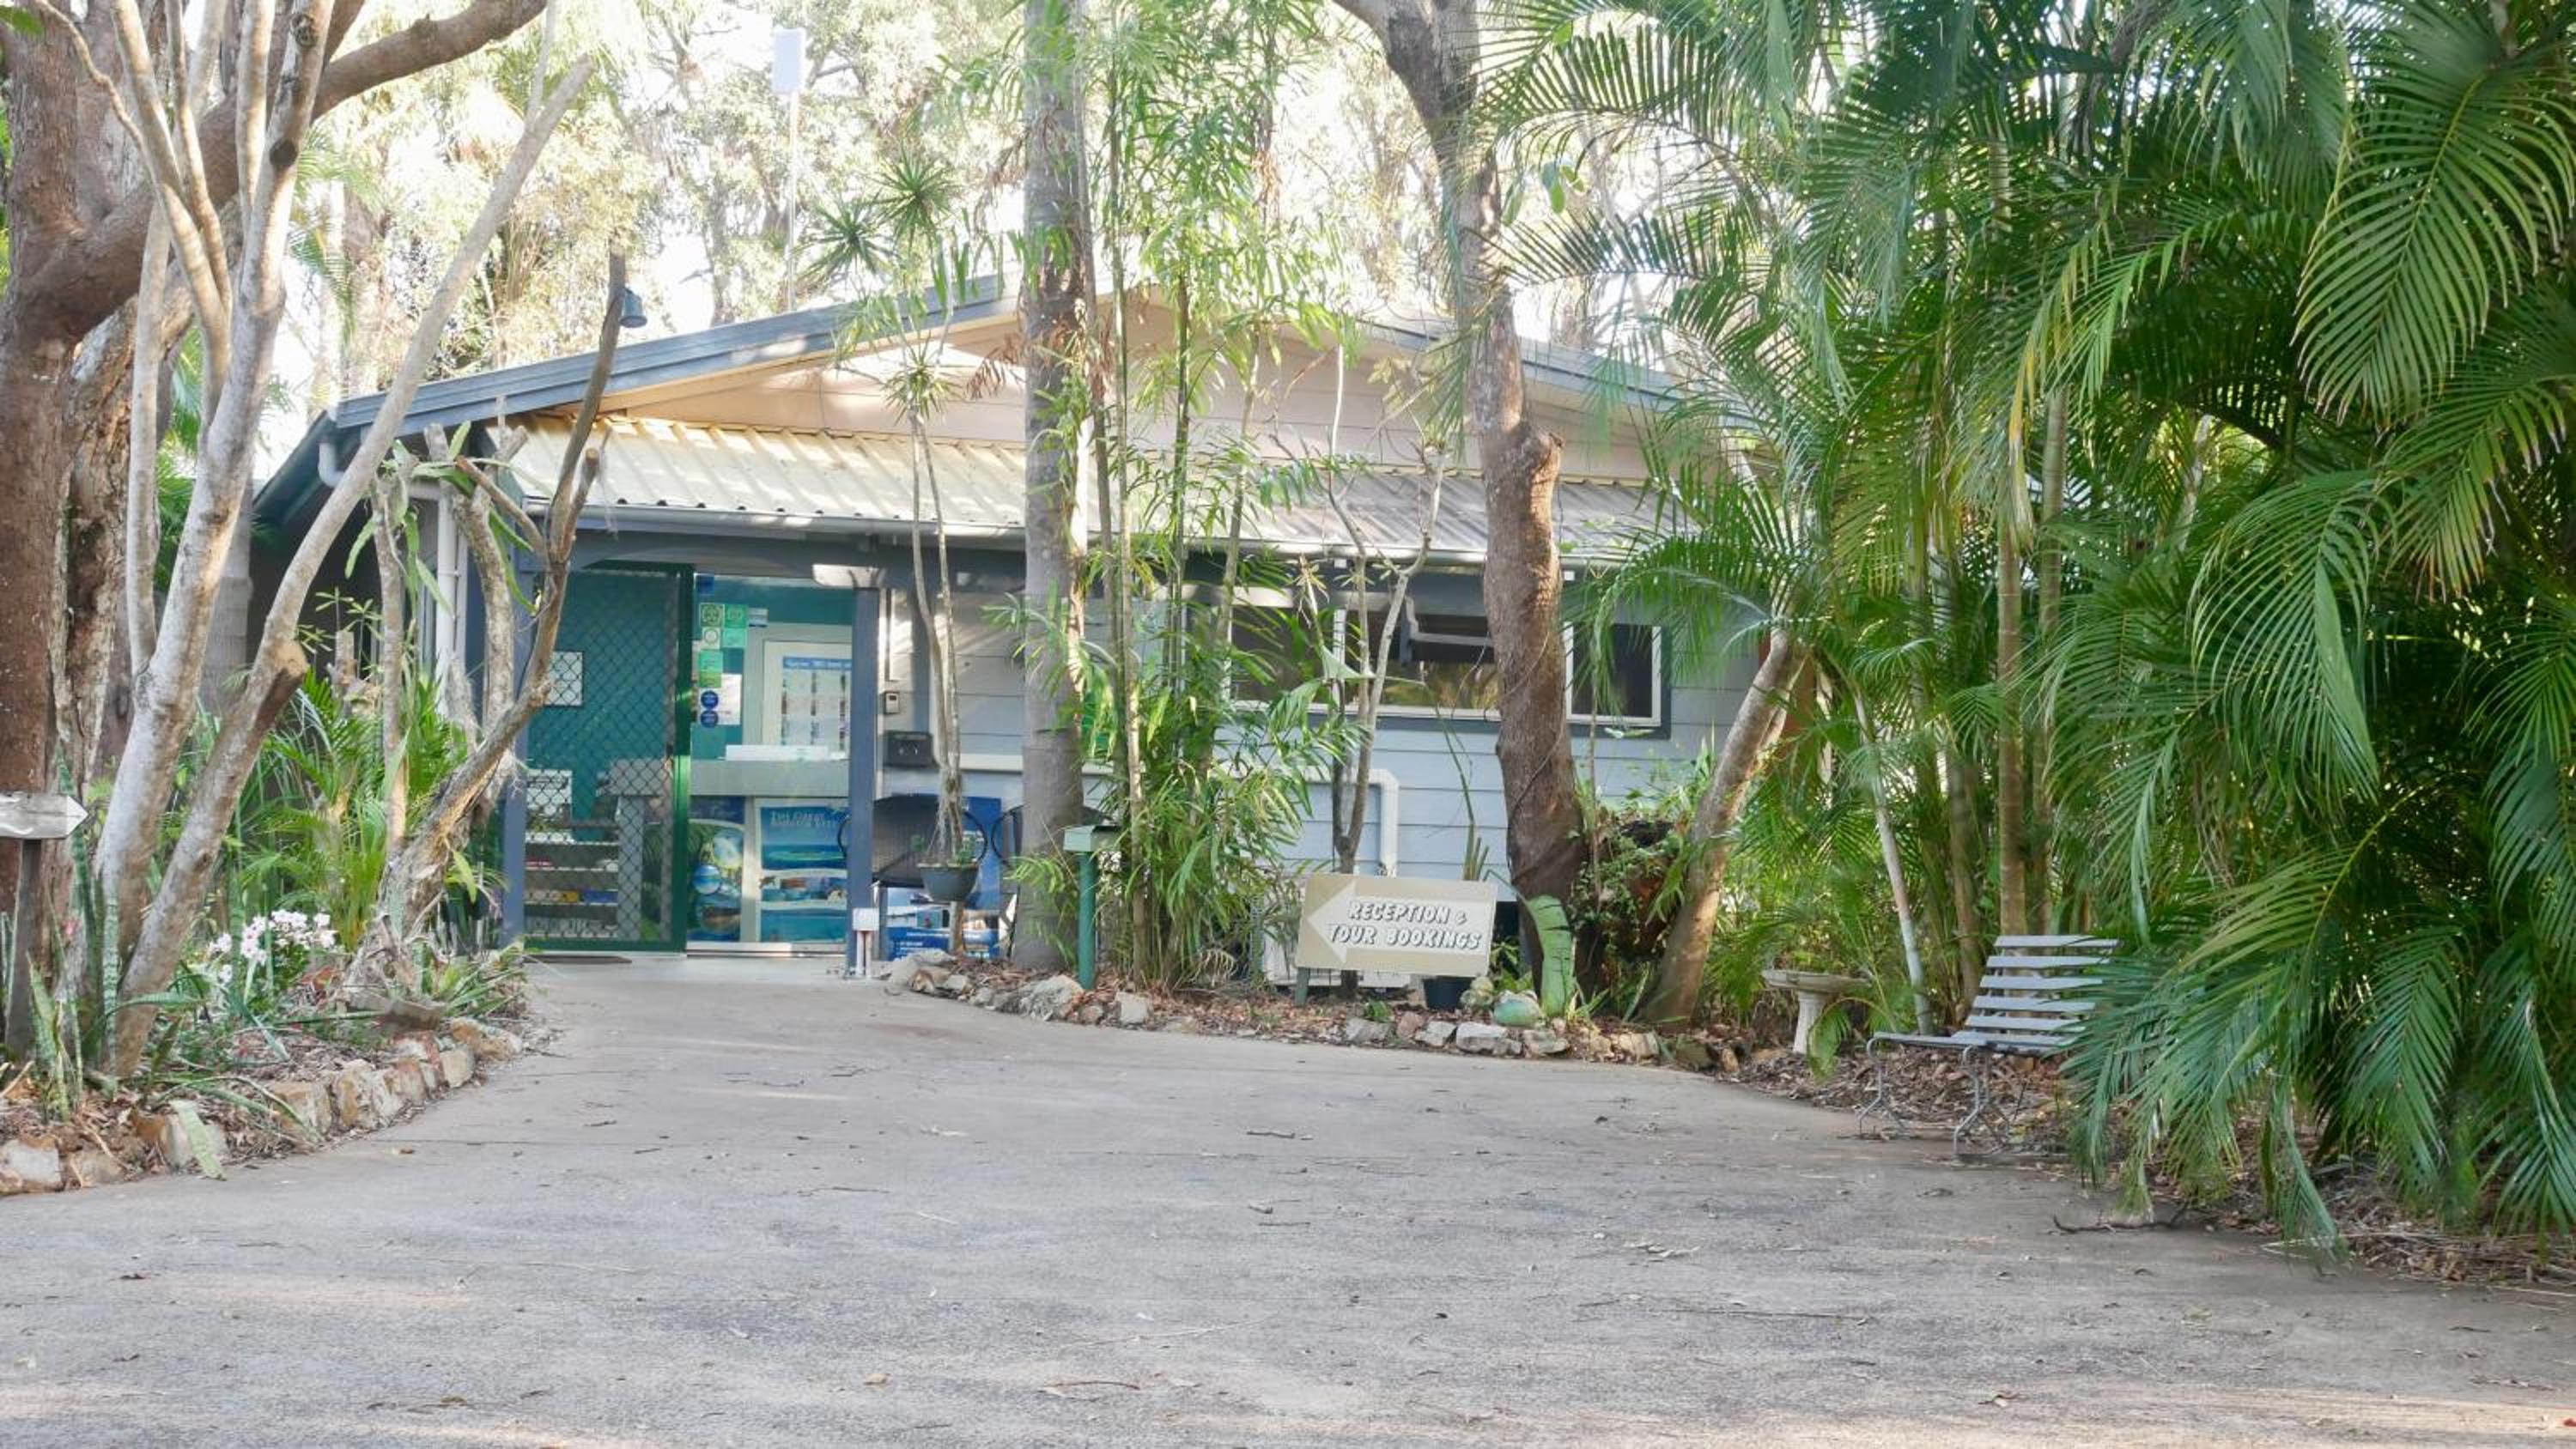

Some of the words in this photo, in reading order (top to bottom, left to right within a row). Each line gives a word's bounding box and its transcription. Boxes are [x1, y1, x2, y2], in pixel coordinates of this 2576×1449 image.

[1348, 901, 1451, 925] RECEPTION
[1455, 910, 1468, 925] &
[1328, 924, 1377, 945] TOUR
[1387, 928, 1483, 950] BOOKINGS
